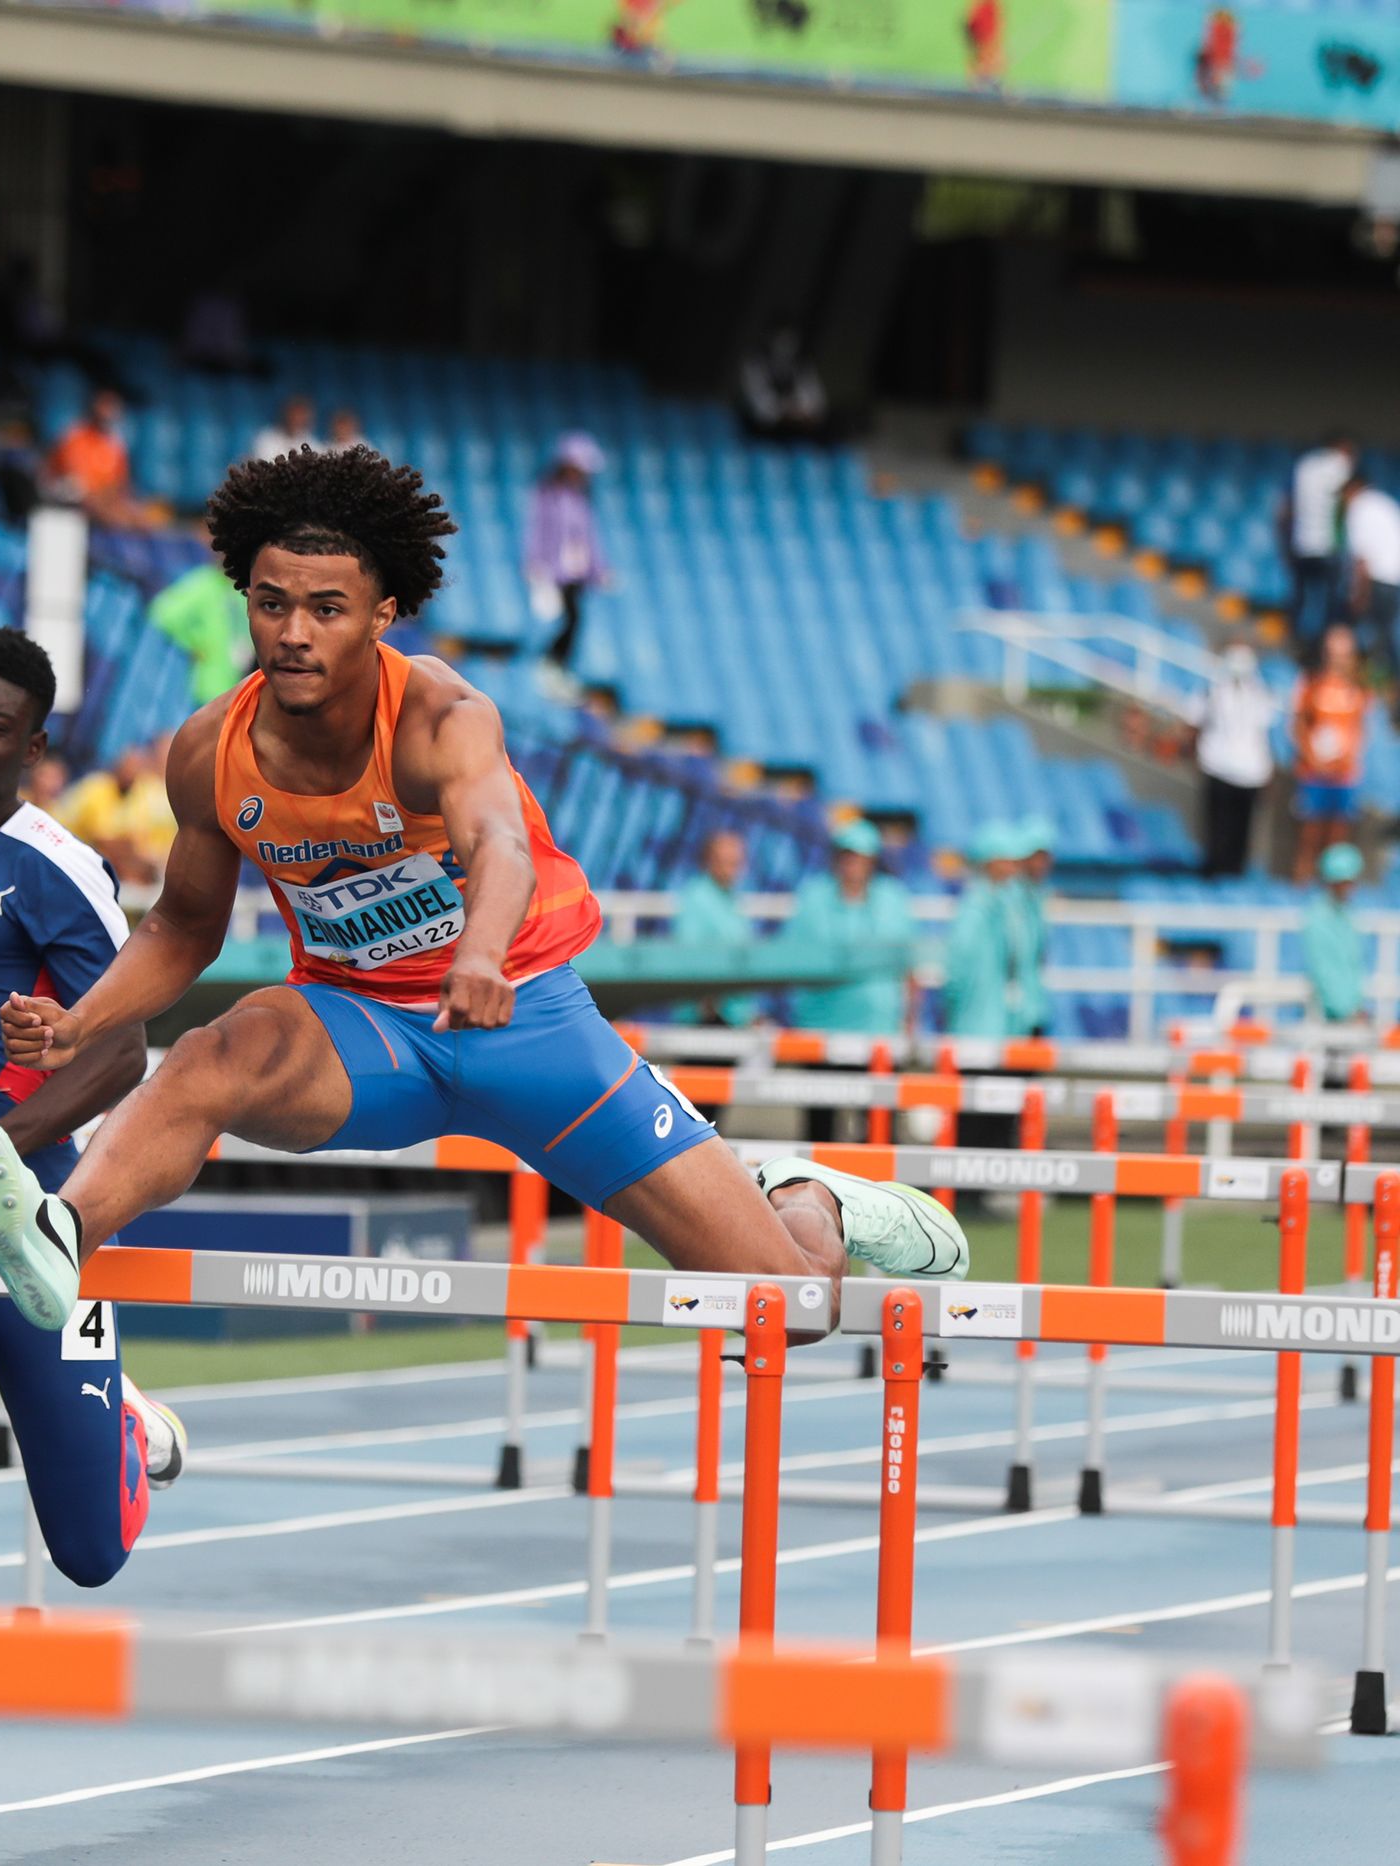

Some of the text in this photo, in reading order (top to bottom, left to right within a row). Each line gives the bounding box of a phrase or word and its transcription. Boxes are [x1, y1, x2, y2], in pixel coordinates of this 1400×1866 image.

[257, 833, 405, 865] Nederland
[314, 865, 418, 911] TDK
[302, 885, 457, 948] EMMANUEL
[368, 921, 460, 961] CALI 22
[955, 1157, 1079, 1186] MONDO
[278, 1263, 451, 1304] MONDO
[79, 1301, 105, 1349] 4
[888, 1418, 905, 1494] MONDO
